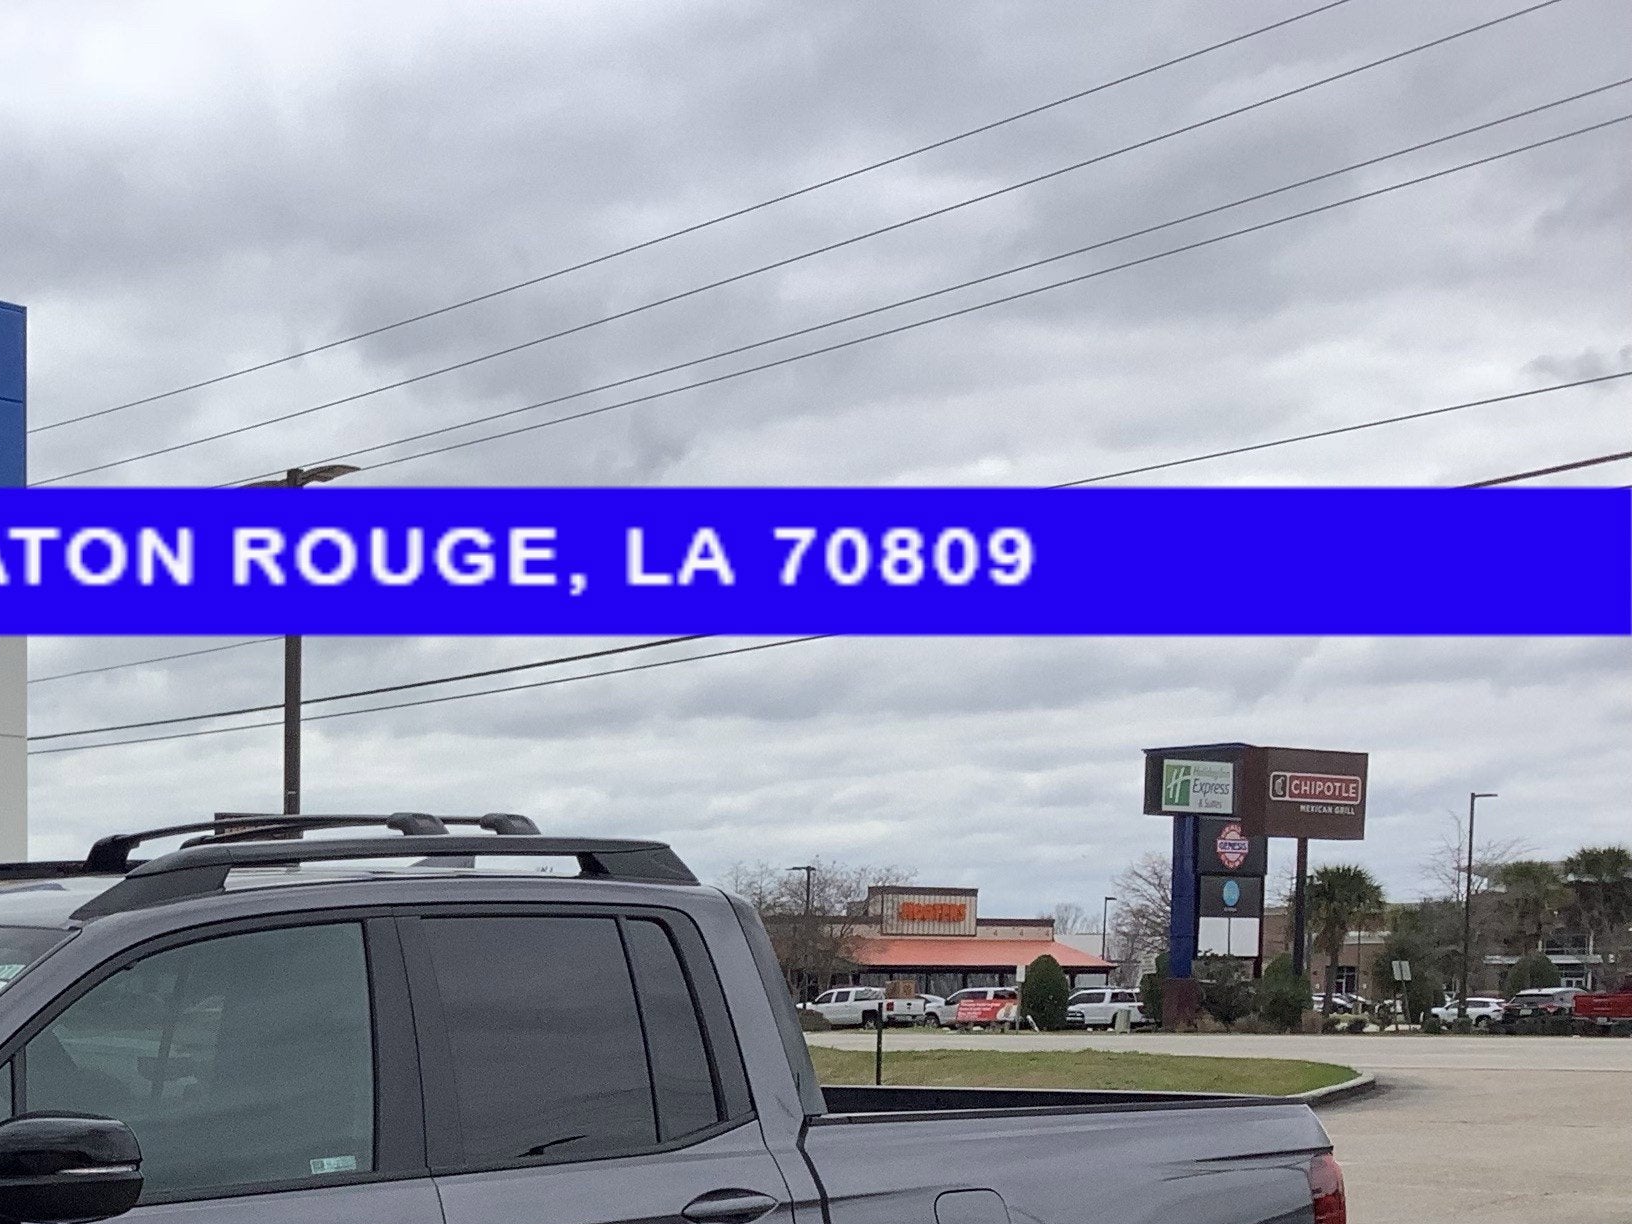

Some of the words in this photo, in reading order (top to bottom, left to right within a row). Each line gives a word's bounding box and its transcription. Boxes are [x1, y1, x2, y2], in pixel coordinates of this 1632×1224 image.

[1192, 779, 1230, 797] Express
[1291, 780, 1356, 798] CHIPOTLE
[1300, 805, 1333, 814] MEXICAN
[1334, 806, 1355, 815] GRILL
